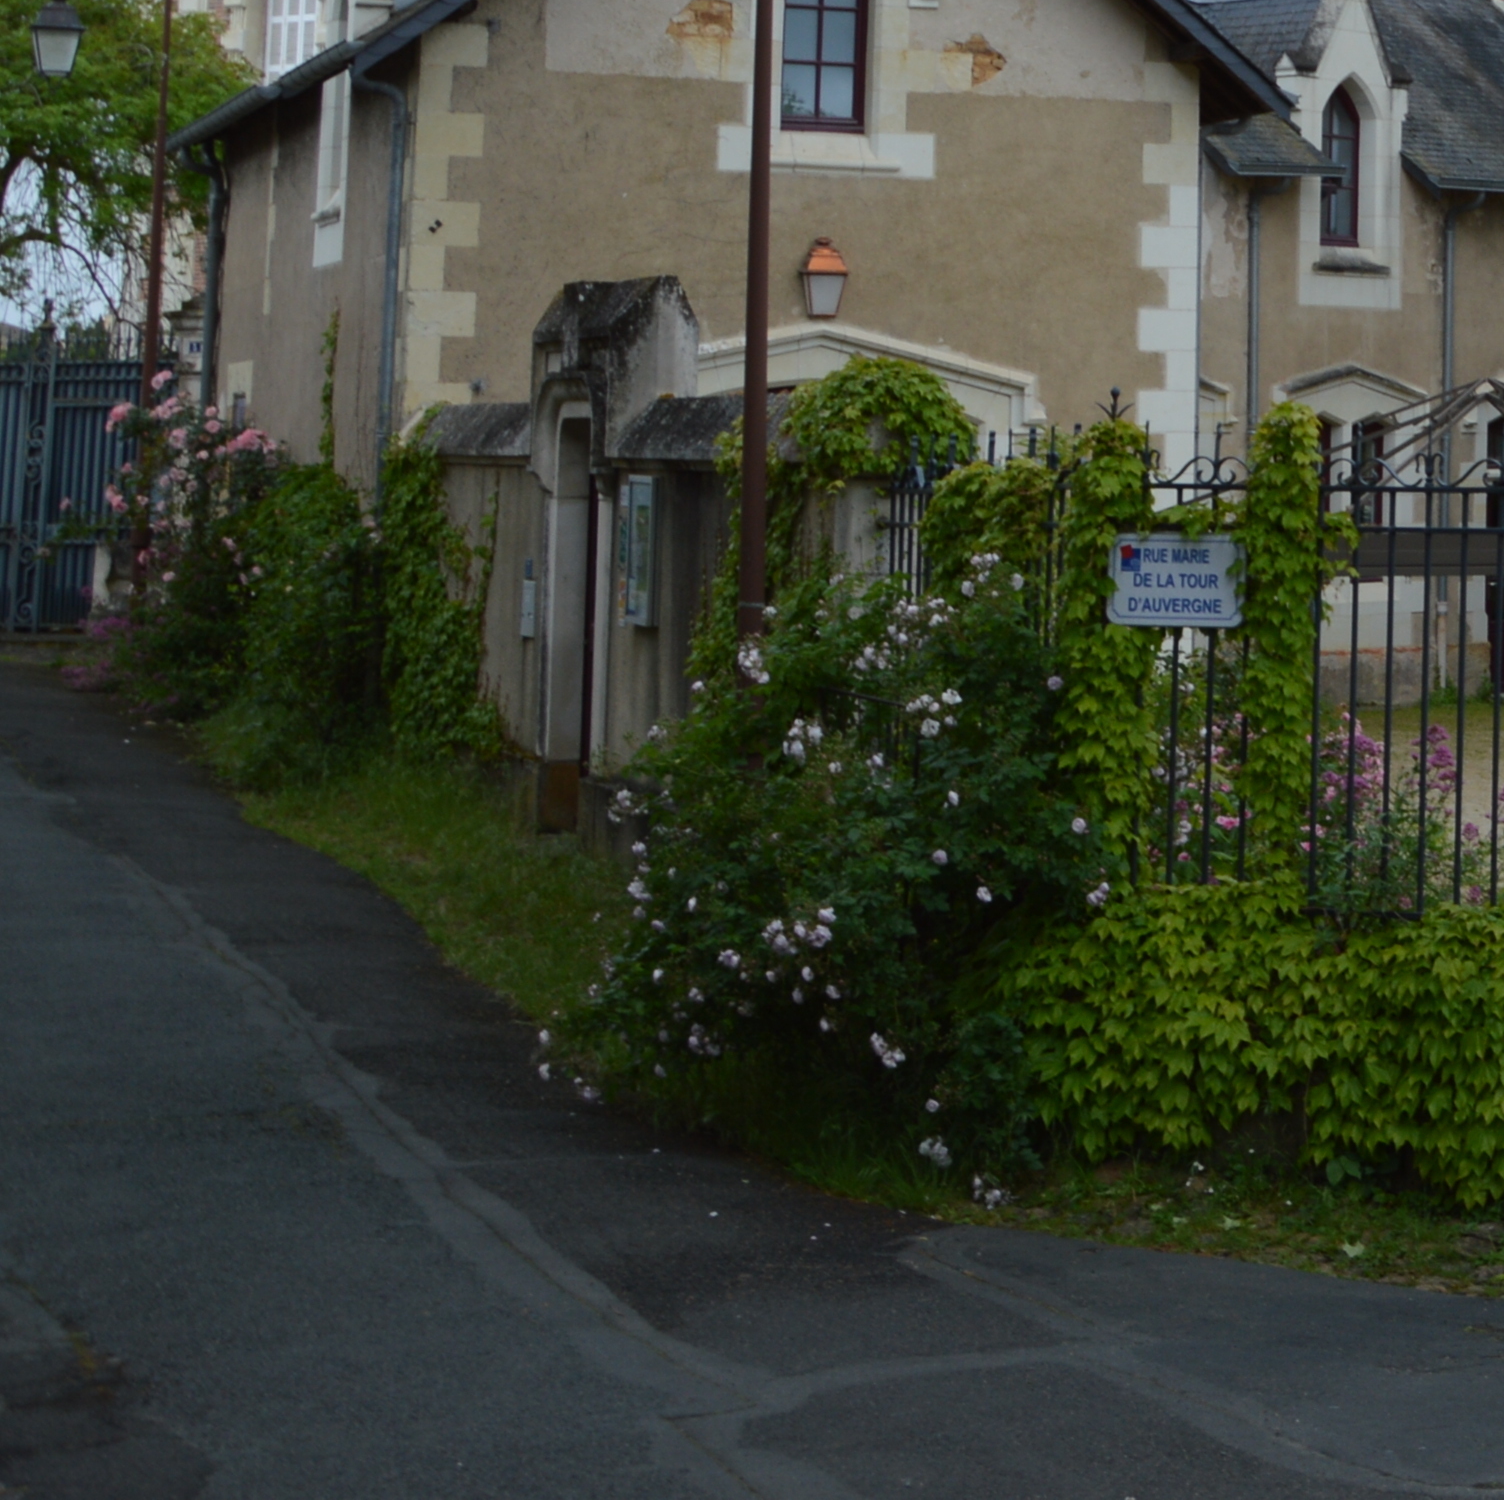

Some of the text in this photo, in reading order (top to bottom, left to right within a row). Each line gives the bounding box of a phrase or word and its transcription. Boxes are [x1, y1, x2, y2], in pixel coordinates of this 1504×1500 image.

[1143, 548, 1210, 564] RUE MARIE
[1133, 573, 1219, 589] DE LA TOUR
[1128, 597, 1222, 614] D'AUVERGNE
